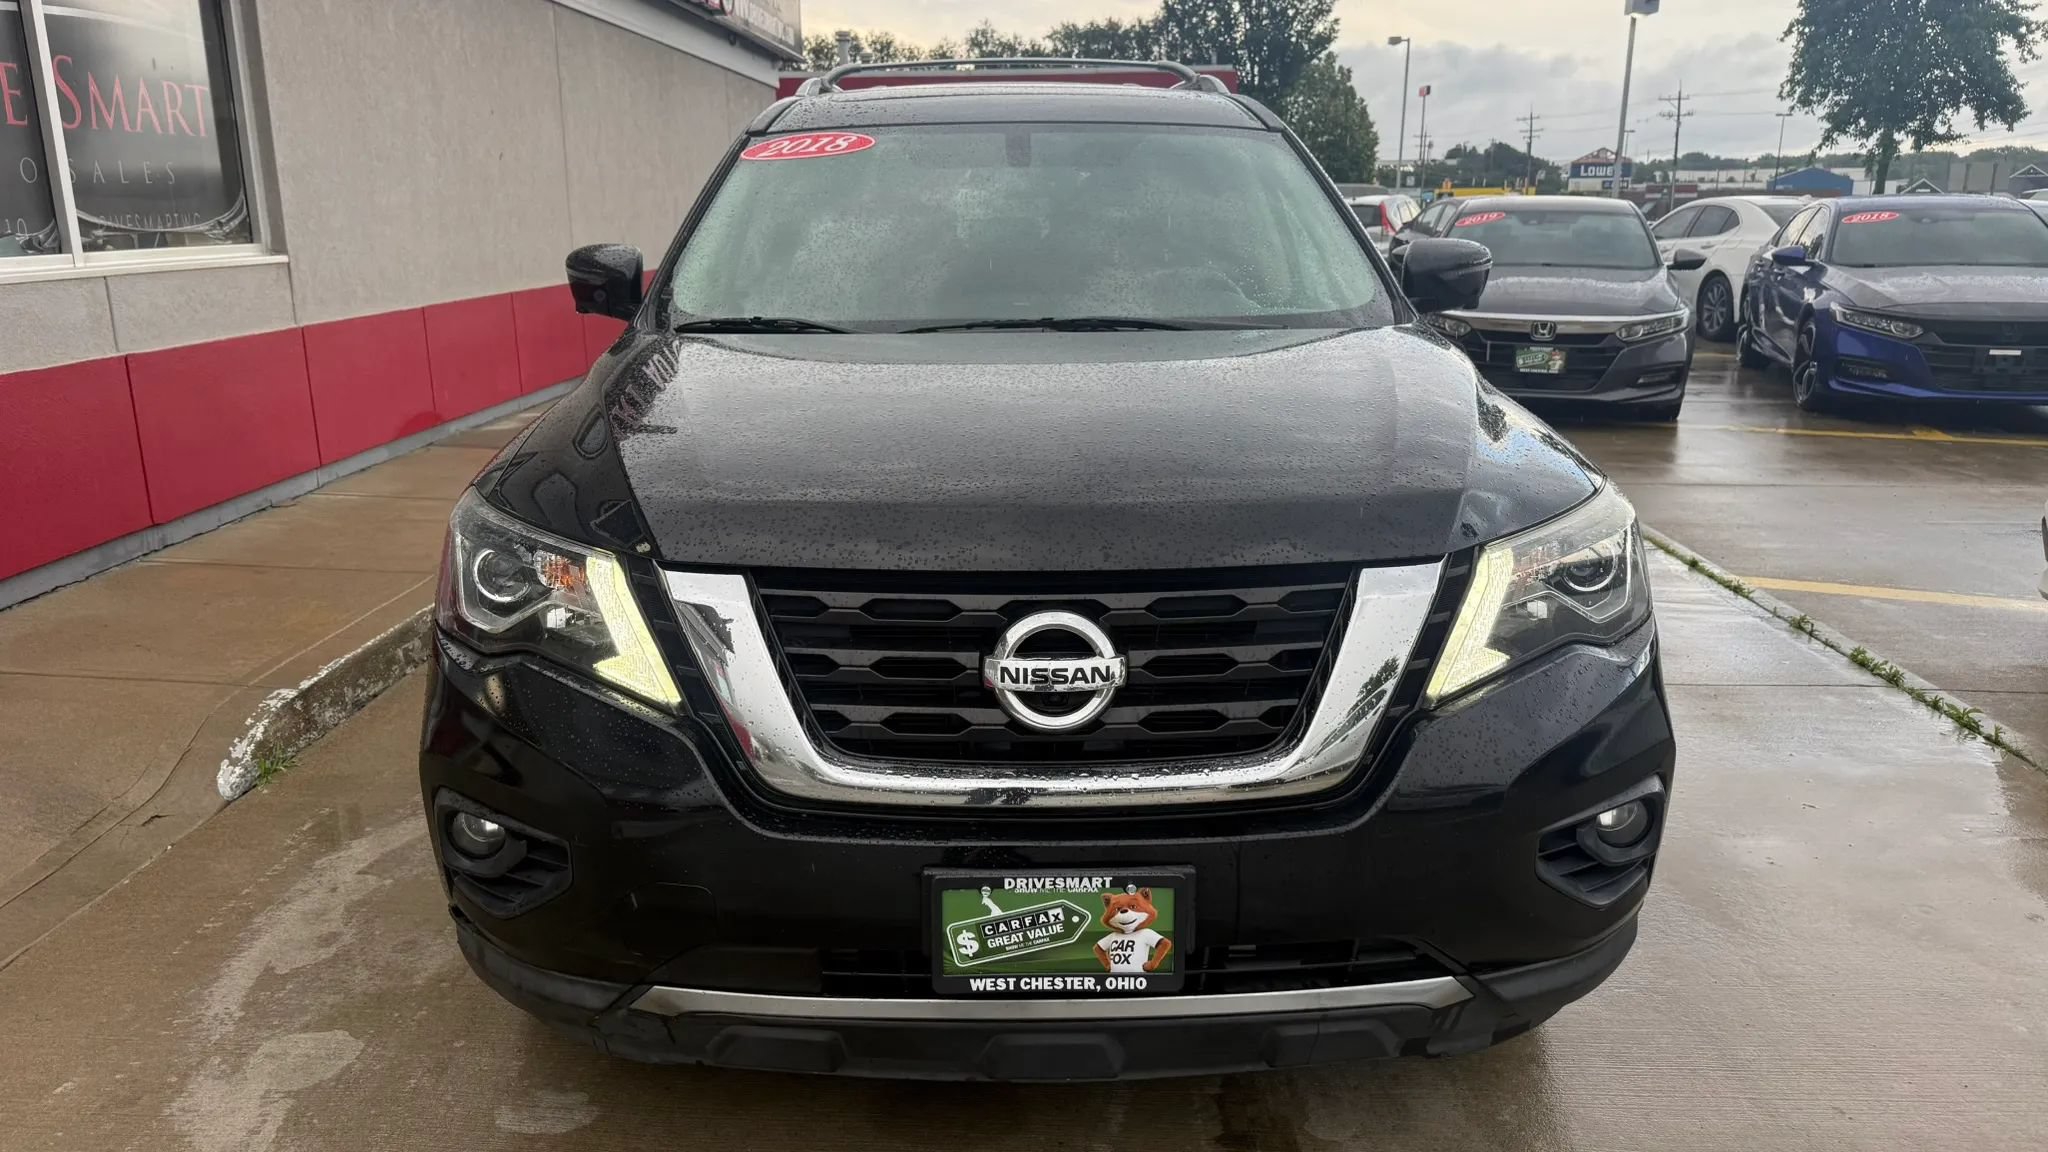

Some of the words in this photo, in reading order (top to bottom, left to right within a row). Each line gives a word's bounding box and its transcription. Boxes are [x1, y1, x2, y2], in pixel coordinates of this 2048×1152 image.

[52, 54, 209, 137] SMART
[756, 135, 858, 158] 2018
[67, 157, 176, 185] SALES
[1580, 165, 1616, 177] LOWE
[1852, 212, 1890, 223] 2018
[1000, 665, 1111, 685] NISSAN
[1004, 877, 1113, 890] DRIVESMART
[983, 911, 1062, 936] CARFAX
[987, 932, 1024, 948] GREAT
[1026, 923, 1064, 941] VALUE
[1110, 940, 1135, 952] CAR
[970, 978, 1016, 991] WEST
[1020, 977, 1101, 992] CHESTER,
[1105, 977, 1147, 990] OHIO
